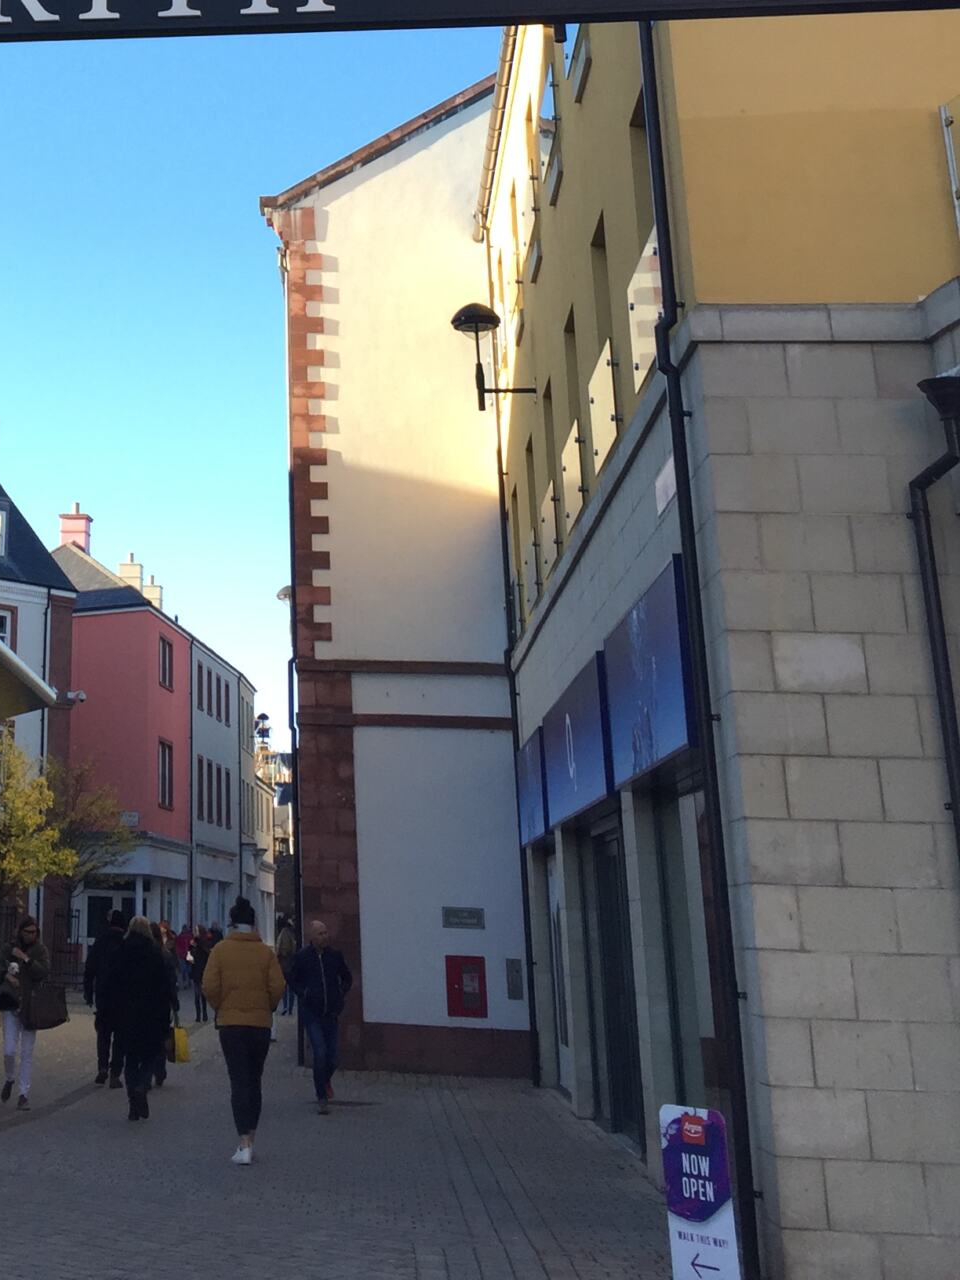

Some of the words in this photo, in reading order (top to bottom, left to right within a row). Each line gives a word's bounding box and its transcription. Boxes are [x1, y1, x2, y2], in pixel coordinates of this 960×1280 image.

[681, 1152, 710, 1178] NOW
[682, 1176, 715, 1203] OPEN
[677, 1230, 695, 1242] WALK
[695, 1233, 712, 1246] THIS
